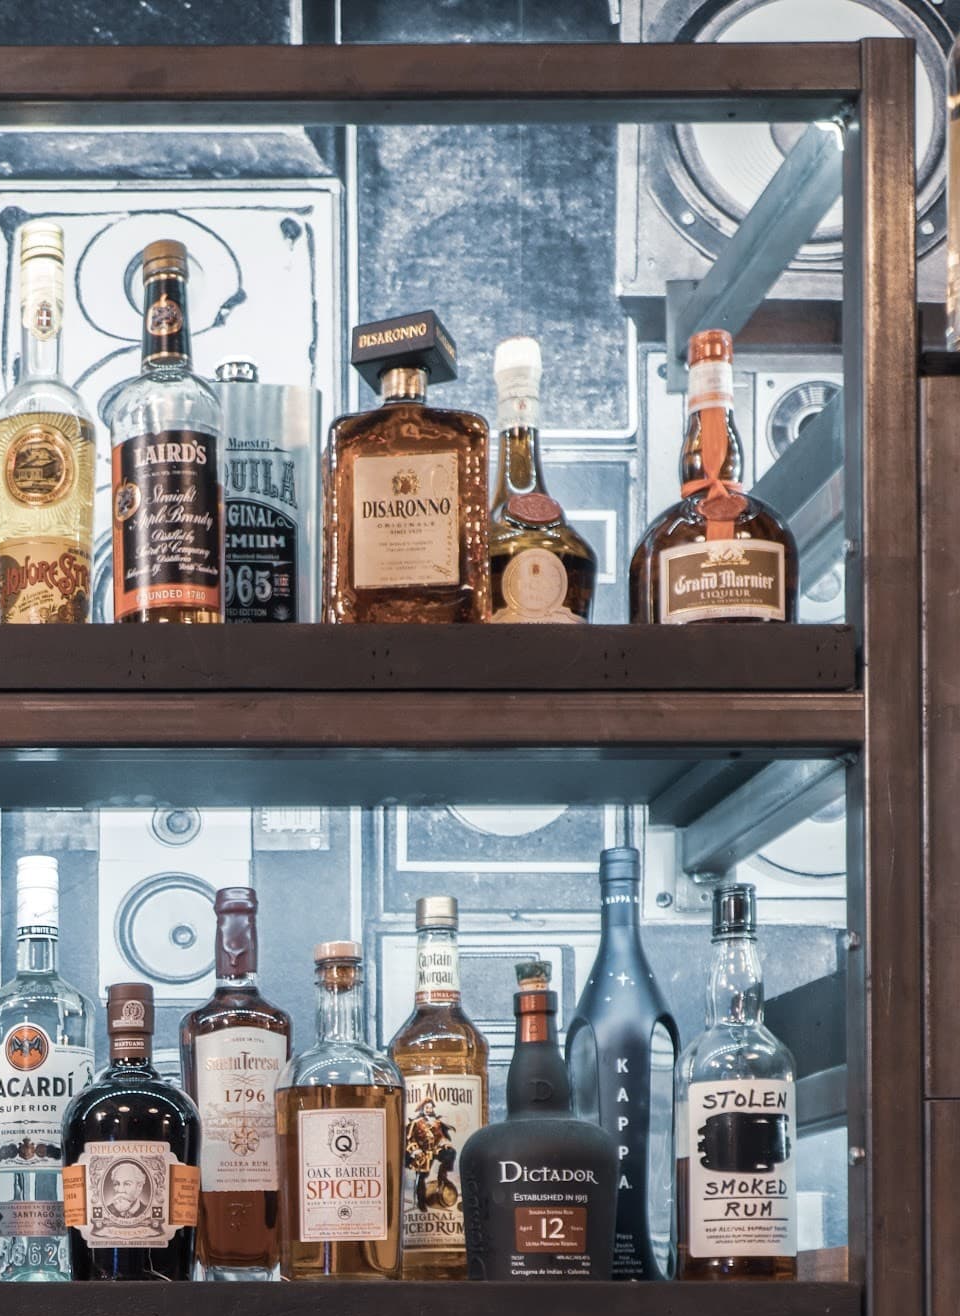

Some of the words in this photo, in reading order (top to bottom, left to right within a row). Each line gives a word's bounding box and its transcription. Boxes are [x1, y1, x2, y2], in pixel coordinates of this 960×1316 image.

[359, 322, 427, 349] DISARONNO
[229, 437, 270, 448] Maestri
[134, 440, 207, 468] LAIRD'S
[225, 458, 298, 510] UILA
[146, 484, 197, 508] Straight
[167, 505, 213, 531] Brandy
[362, 498, 451, 519] DISARONNO
[674, 571, 717, 595] Grand
[719, 569, 775, 590] Marnier
[186, 591, 206, 601] 1780
[701, 590, 751, 600] LIQUEUR
[418, 952, 452, 968] Captain
[418, 971, 453, 985] Morgan
[224, 1089, 266, 1103] 1796
[425, 1083, 473, 1105] Morgan
[703, 1088, 787, 1110] STOLEN
[0, 1104, 57, 1113] SUPERIOR
[616, 1058, 634, 1189] KAPPA
[335, 1135, 352, 1152] Q
[307, 1168, 331, 1178] OAK
[335, 1166, 380, 1178] BARREL
[306, 1179, 382, 1200] SPICED
[705, 1179, 787, 1196] SMOKED
[513, 1193, 564, 1202] ESTABLISHED
[724, 1200, 772, 1217] RUM
[541, 1217, 566, 1239] 12
